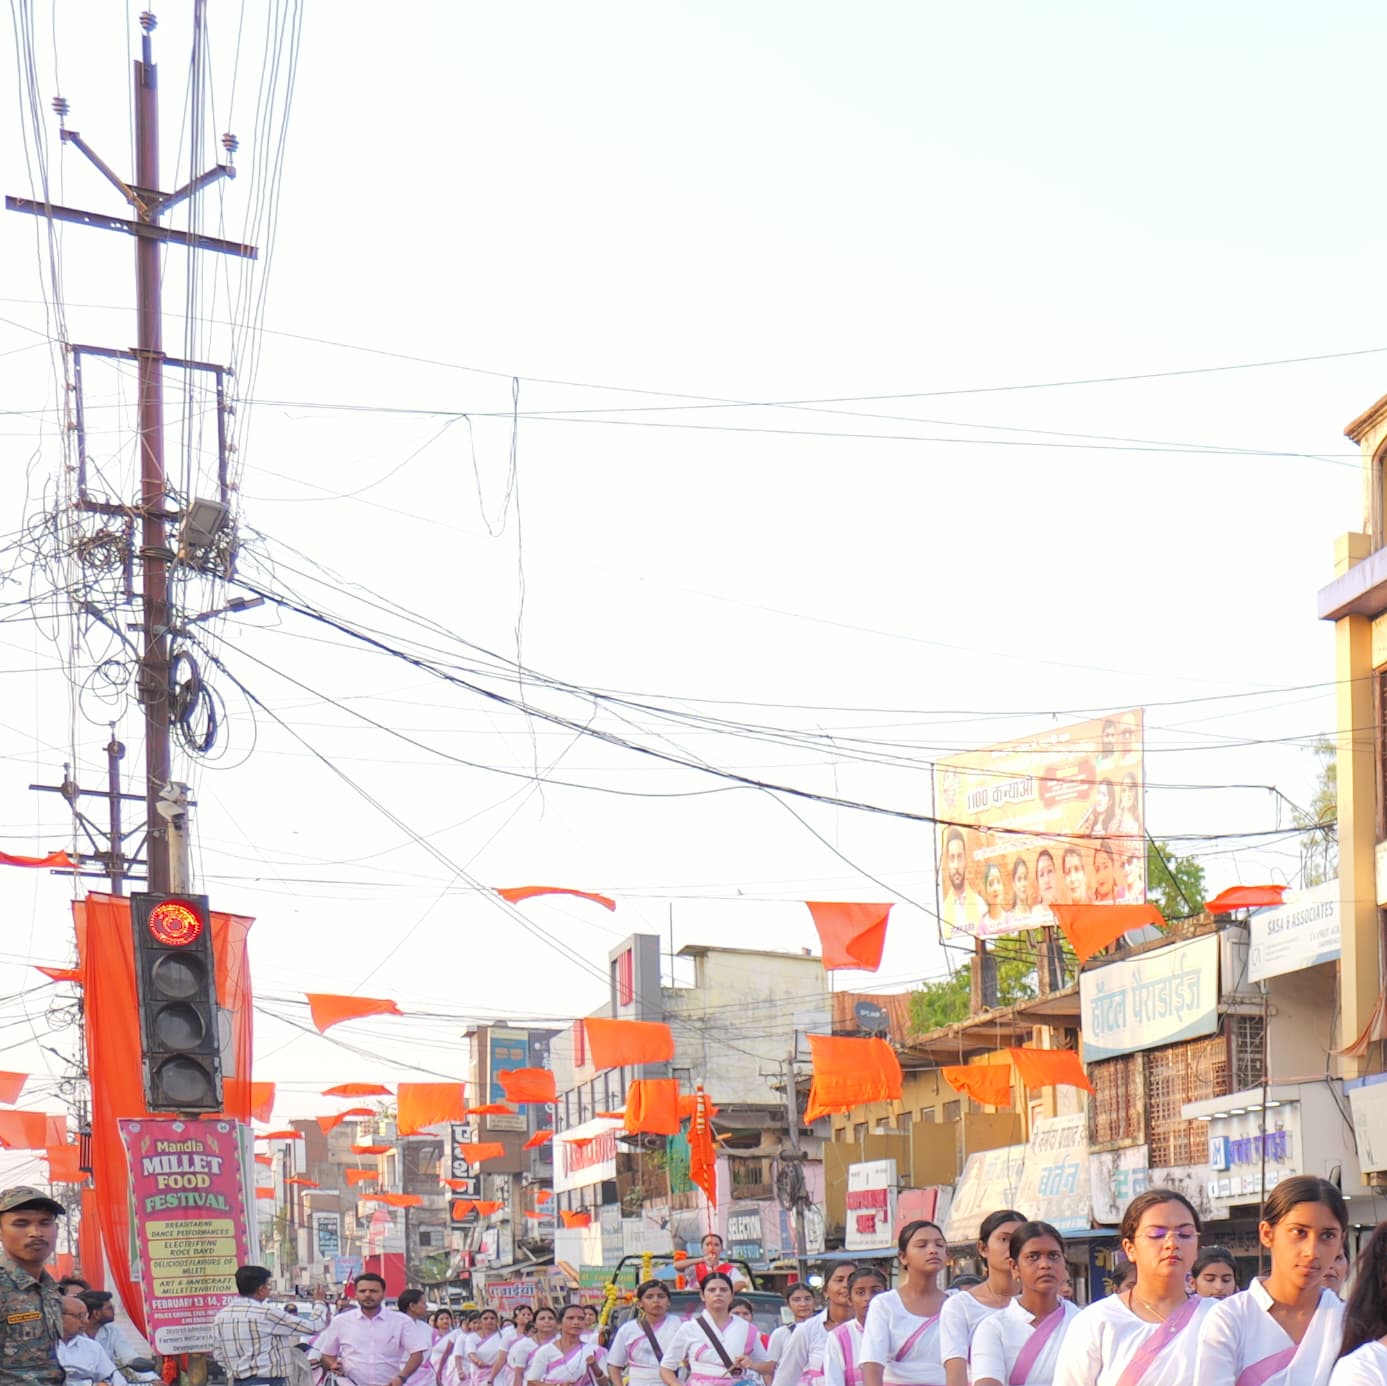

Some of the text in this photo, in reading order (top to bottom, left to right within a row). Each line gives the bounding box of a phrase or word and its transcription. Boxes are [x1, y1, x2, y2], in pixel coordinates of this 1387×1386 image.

[1291, 901, 1334, 928] ASSOCIATES
[157, 1140, 204, 1152] Mandla
[142, 1154, 223, 1176] MILLET
[157, 1174, 211, 1189] FOOD
[145, 1192, 230, 1213] FESTIVAL
[177, 1229, 230, 1237] PERFORMANCES
[728, 1215, 762, 1241] SELECTION
[152, 1299, 192, 1310] FEBRUARY
